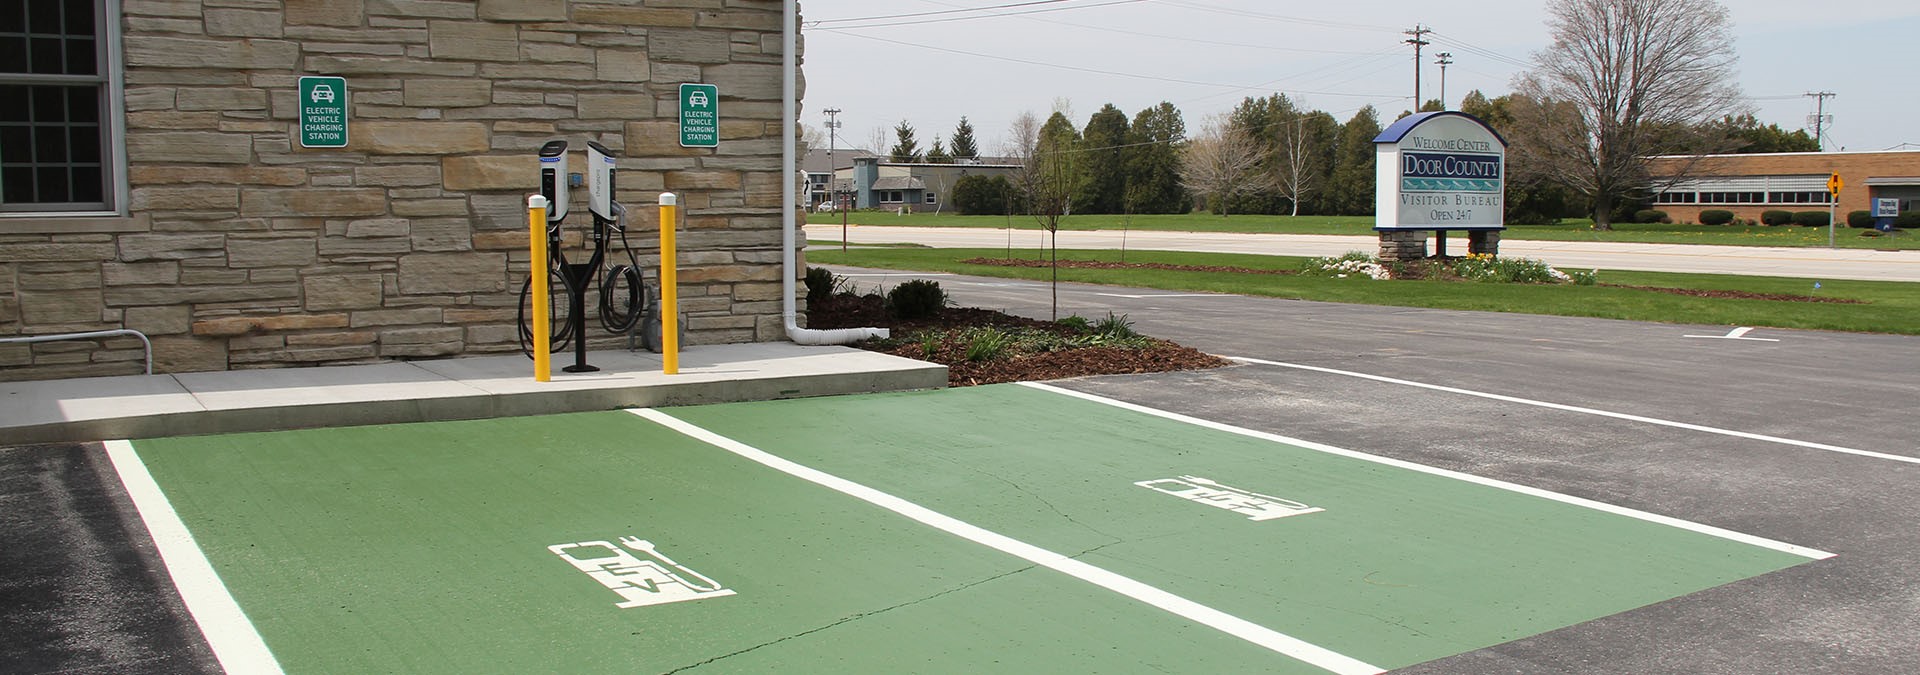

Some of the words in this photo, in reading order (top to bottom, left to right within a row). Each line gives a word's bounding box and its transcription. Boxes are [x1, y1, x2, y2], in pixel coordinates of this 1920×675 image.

[1413, 137, 1455, 149] WELCOME
[1457, 138, 1491, 151] CENTER
[1404, 154, 1443, 175] DOOR
[1444, 156, 1499, 177] COUNTY
[1401, 194, 1448, 206] VISITOR
[1455, 194, 1499, 206] BUREAU
[1430, 209, 1453, 220] OPEN
[1456, 209, 1472, 220] 24/7
